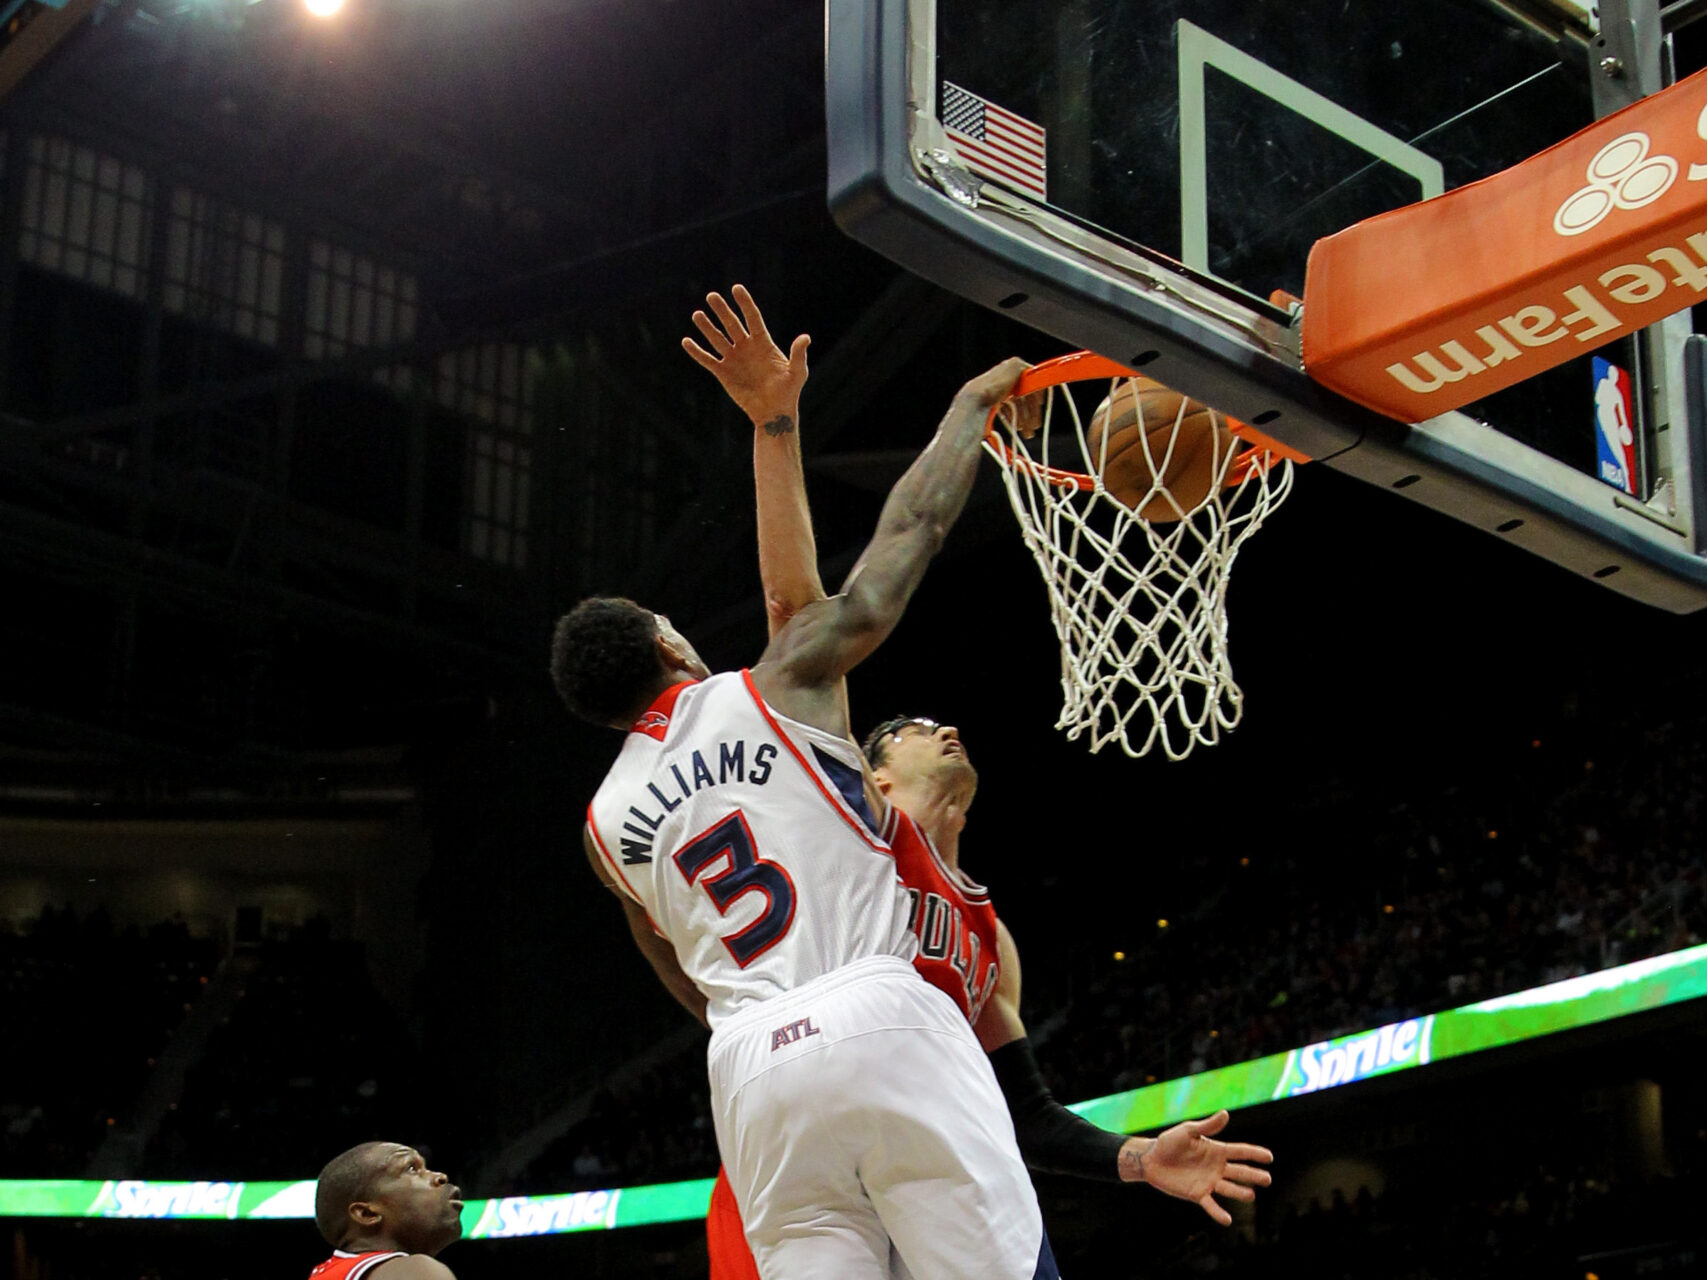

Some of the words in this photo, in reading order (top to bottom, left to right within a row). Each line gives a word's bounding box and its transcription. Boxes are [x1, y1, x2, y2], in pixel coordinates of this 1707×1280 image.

[620, 740, 778, 866] WILLIAMS
[673, 808, 797, 970] 3
[771, 1016, 820, 1052] ATL
[1292, 1018, 1419, 1095] Sprite
[104, 1180, 231, 1218] Sprite
[490, 1191, 609, 1239] Sprite
